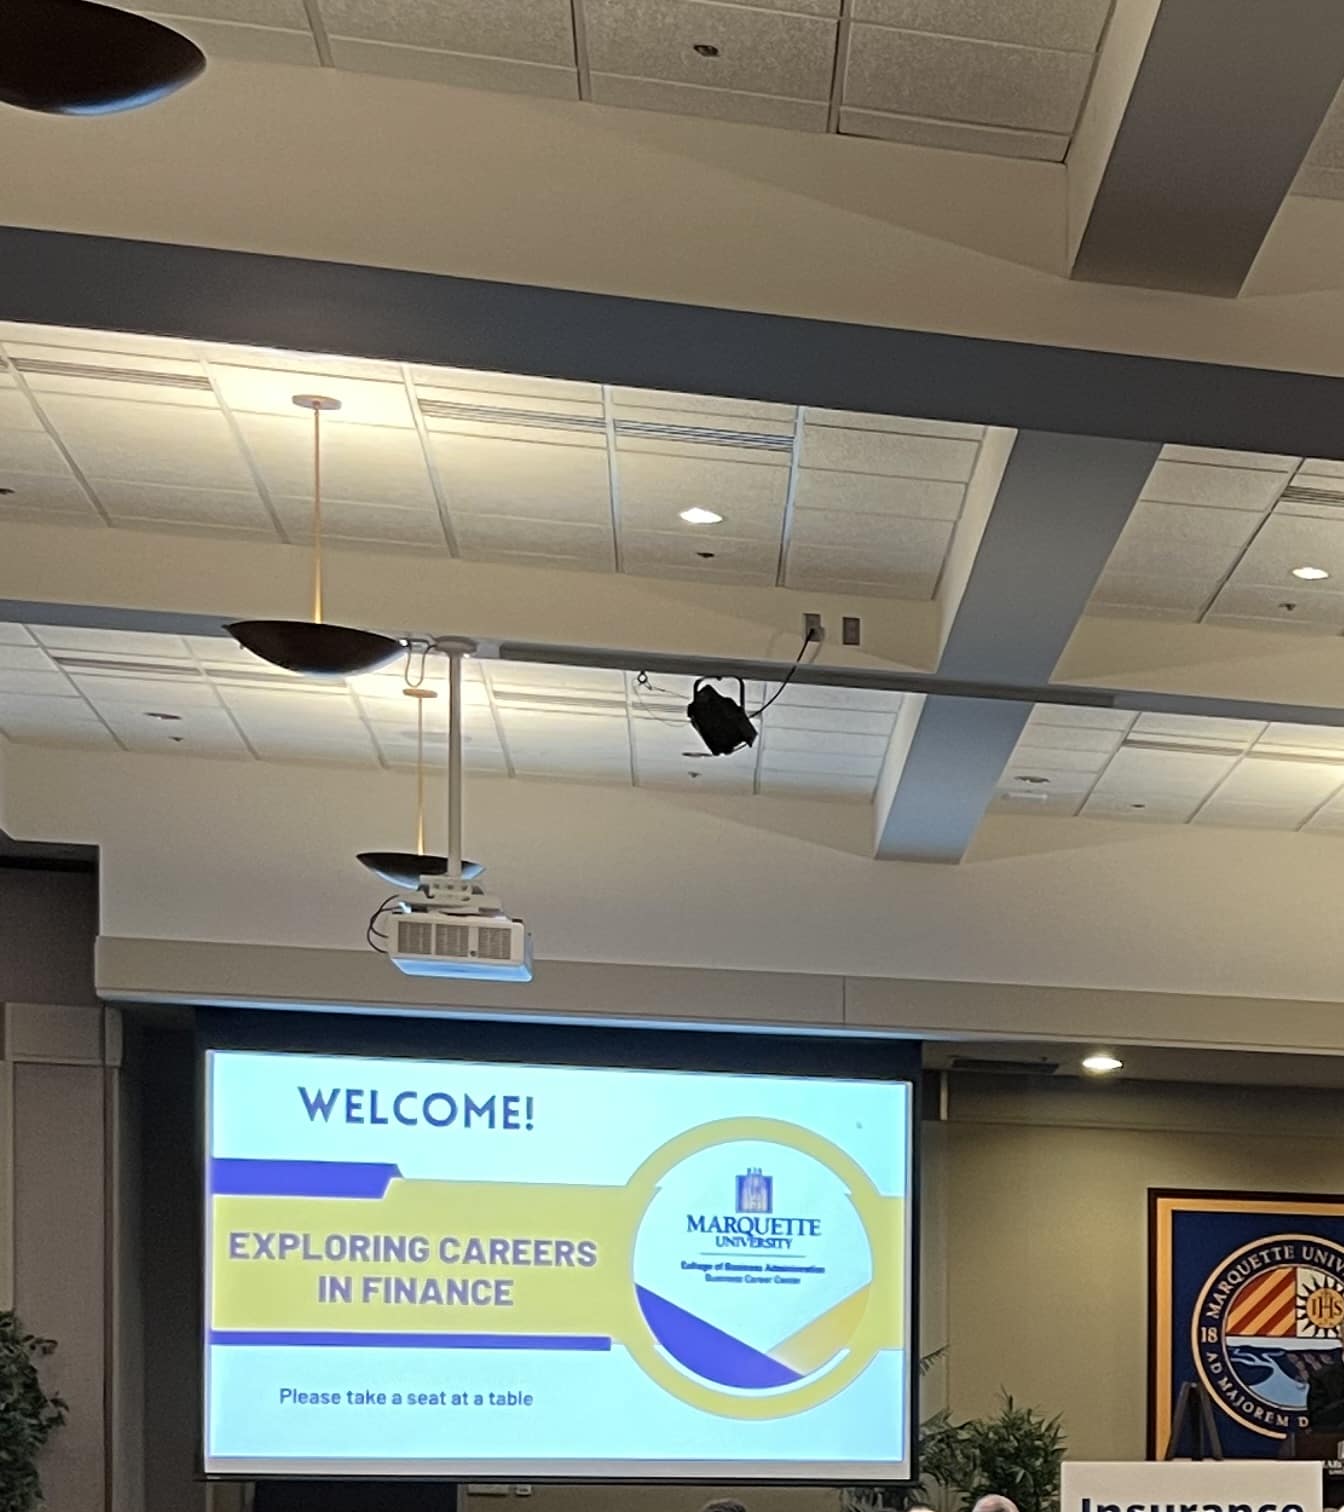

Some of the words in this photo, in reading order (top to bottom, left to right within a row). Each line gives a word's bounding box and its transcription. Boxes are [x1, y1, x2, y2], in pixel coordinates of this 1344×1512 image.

[297, 1086, 534, 1131] WELCOME!
[686, 1214, 822, 1237] MARQUETTE
[228, 1232, 430, 1262] EXPLORING
[439, 1237, 598, 1267] CAREERS
[716, 1236, 793, 1249] UNIVERSITY
[317, 1275, 352, 1303] IN
[361, 1277, 515, 1306] FINANCE
[1206, 1245, 1295, 1319] MARQUETTE
[1311, 1295, 1343, 1318] IHS
[1201, 1328, 1218, 1343] 18
[279, 1388, 342, 1405] Please
[346, 1389, 387, 1405] take
[391, 1393, 402, 1406] a
[407, 1391, 447, 1406] seat
[451, 1392, 469, 1406] at
[473, 1394, 484, 1406] a
[488, 1391, 534, 1407] table
[1206, 1352, 1222, 1374] AD
[1217, 1377, 1289, 1427] MAJOREM
